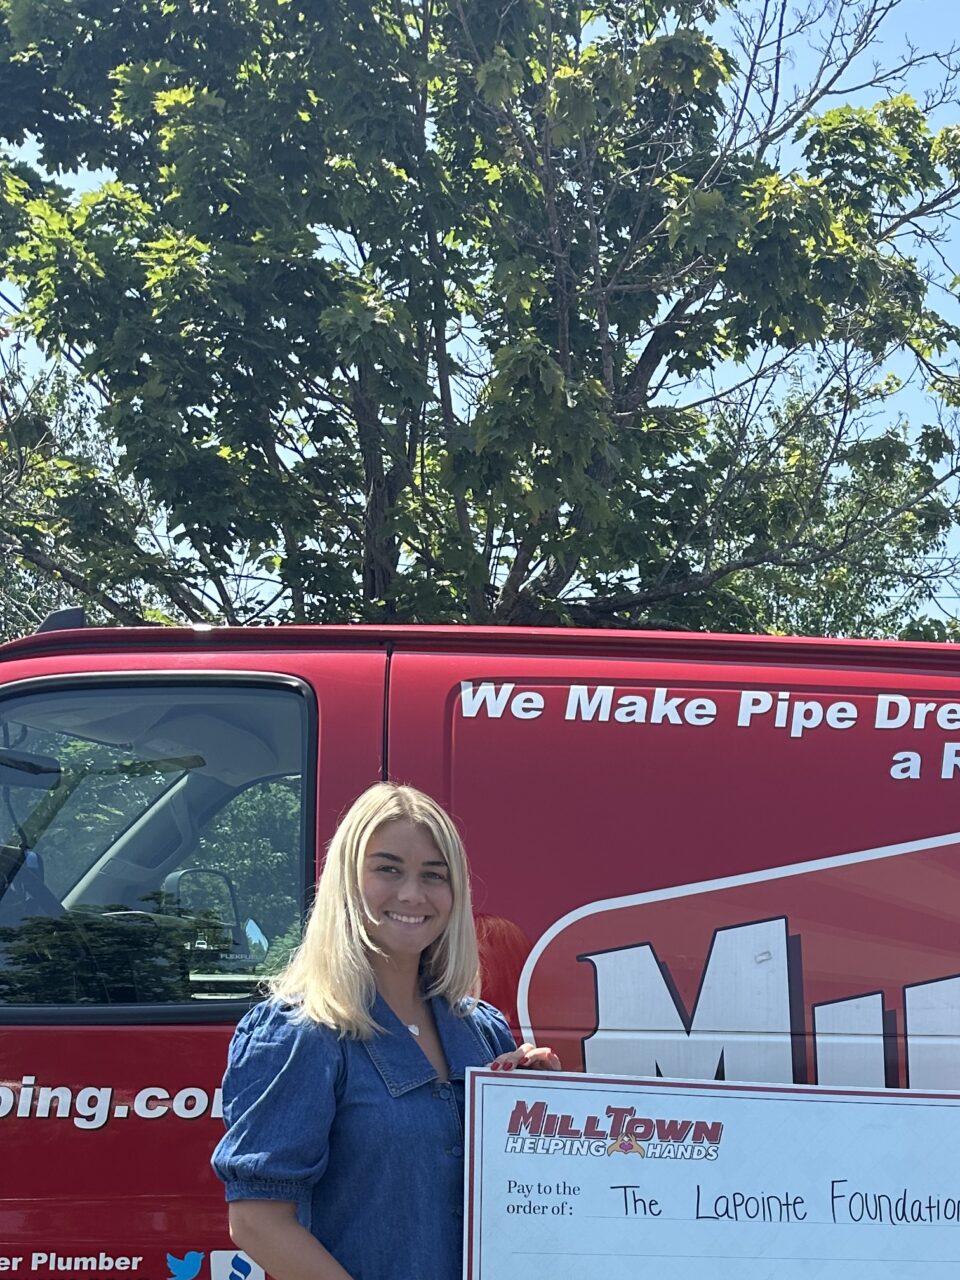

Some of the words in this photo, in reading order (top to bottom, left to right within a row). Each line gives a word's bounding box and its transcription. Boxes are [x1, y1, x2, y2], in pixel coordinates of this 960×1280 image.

[459, 681, 545, 719] We
[564, 685, 718, 727] Make
[736, 691, 858, 737] Pipe
[890, 752, 922, 780] a
[505, 1137, 607, 1158] HELPING
[646, 1142, 720, 1162] HANDS
[507, 1180, 534, 1200] Pay
[537, 1183, 551, 1196] to
[555, 1182, 581, 1197] the
[611, 1185, 663, 1218] The
[506, 1201, 548, 1217] order
[551, 1201, 574, 1217] of:
[31, 1252, 143, 1271] Plumber
